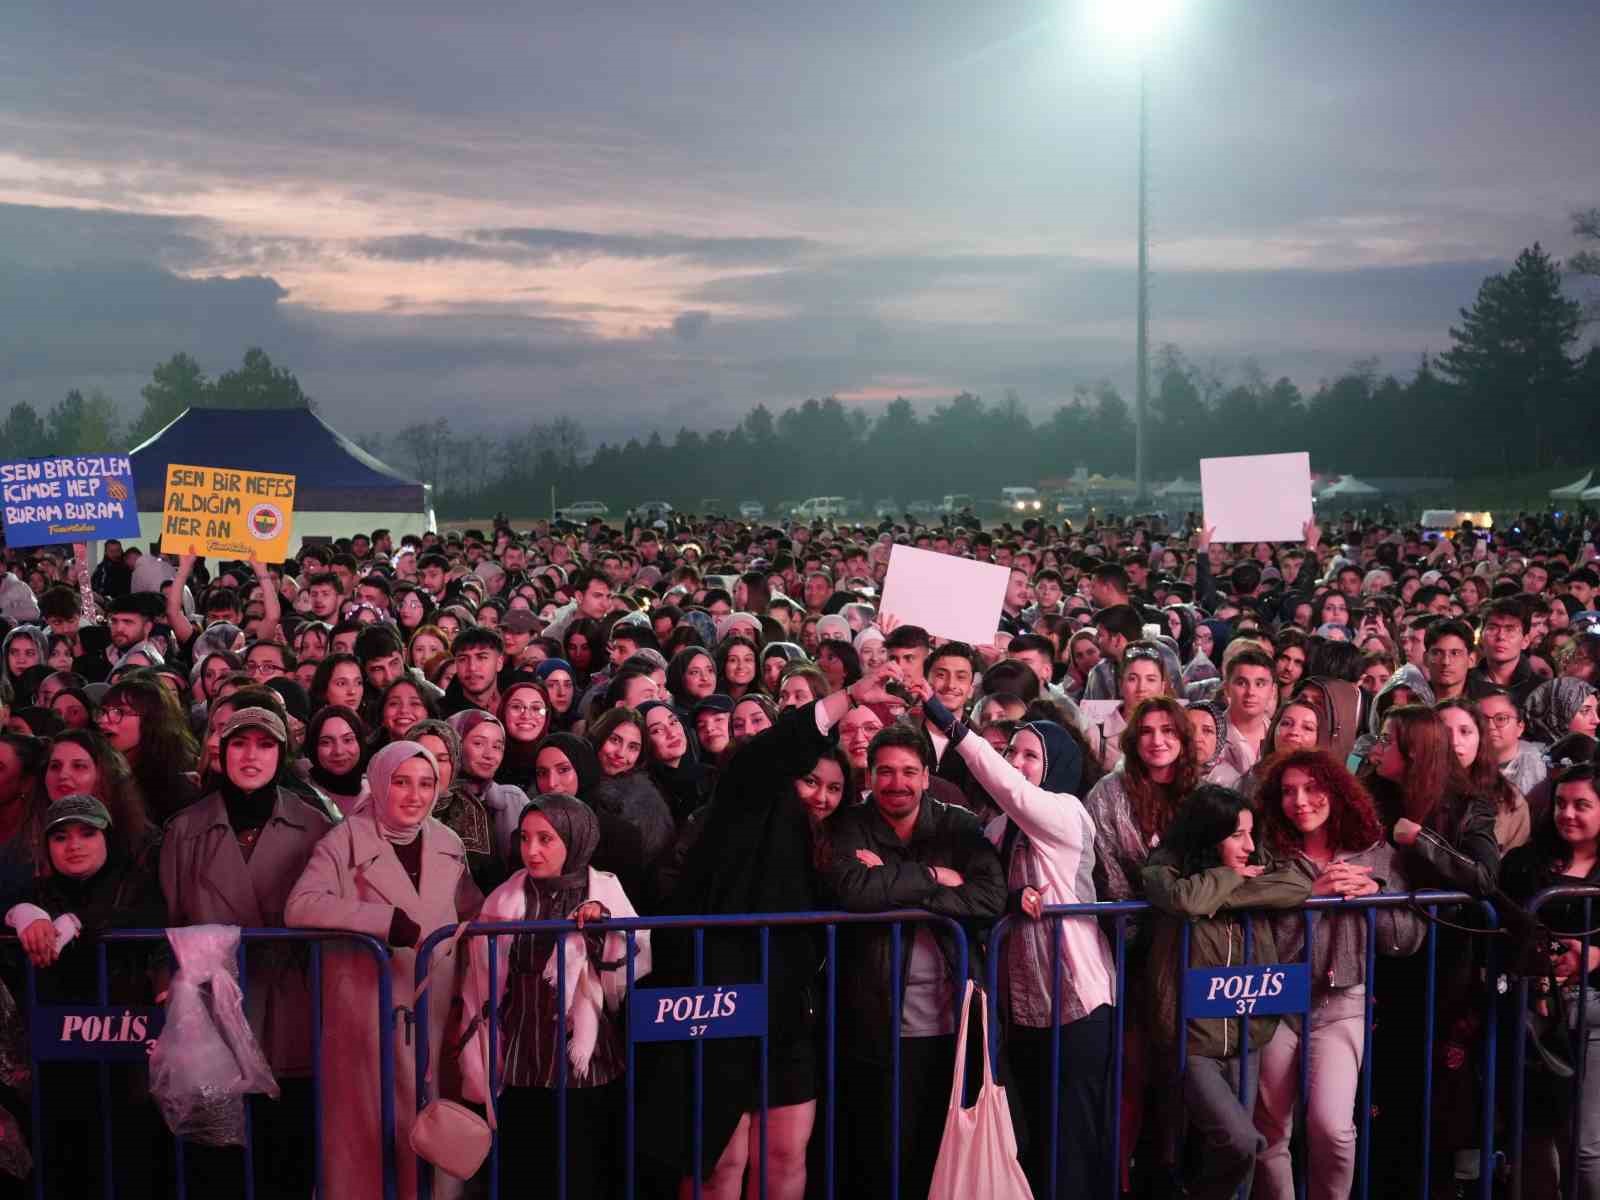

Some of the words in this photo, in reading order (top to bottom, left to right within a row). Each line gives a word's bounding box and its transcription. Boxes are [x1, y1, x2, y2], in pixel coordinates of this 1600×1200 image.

[0, 463, 41, 482] SEN
[76, 457, 131, 476] ÖZLEM
[170, 469, 205, 487] SEN
[66, 478, 101, 498] HEP
[5, 505, 63, 525] BURAM
[64, 502, 125, 520] BURAM
[167, 492, 241, 515] ALDIĞIM
[167, 515, 202, 537] HER
[206, 519, 230, 538] AN
[1207, 968, 1285, 1000] POLİS
[654, 987, 737, 1023] POLİS
[1235, 999, 1257, 1015] 37
[60, 1009, 148, 1042] POLİS
[689, 1025, 708, 1036] 37
